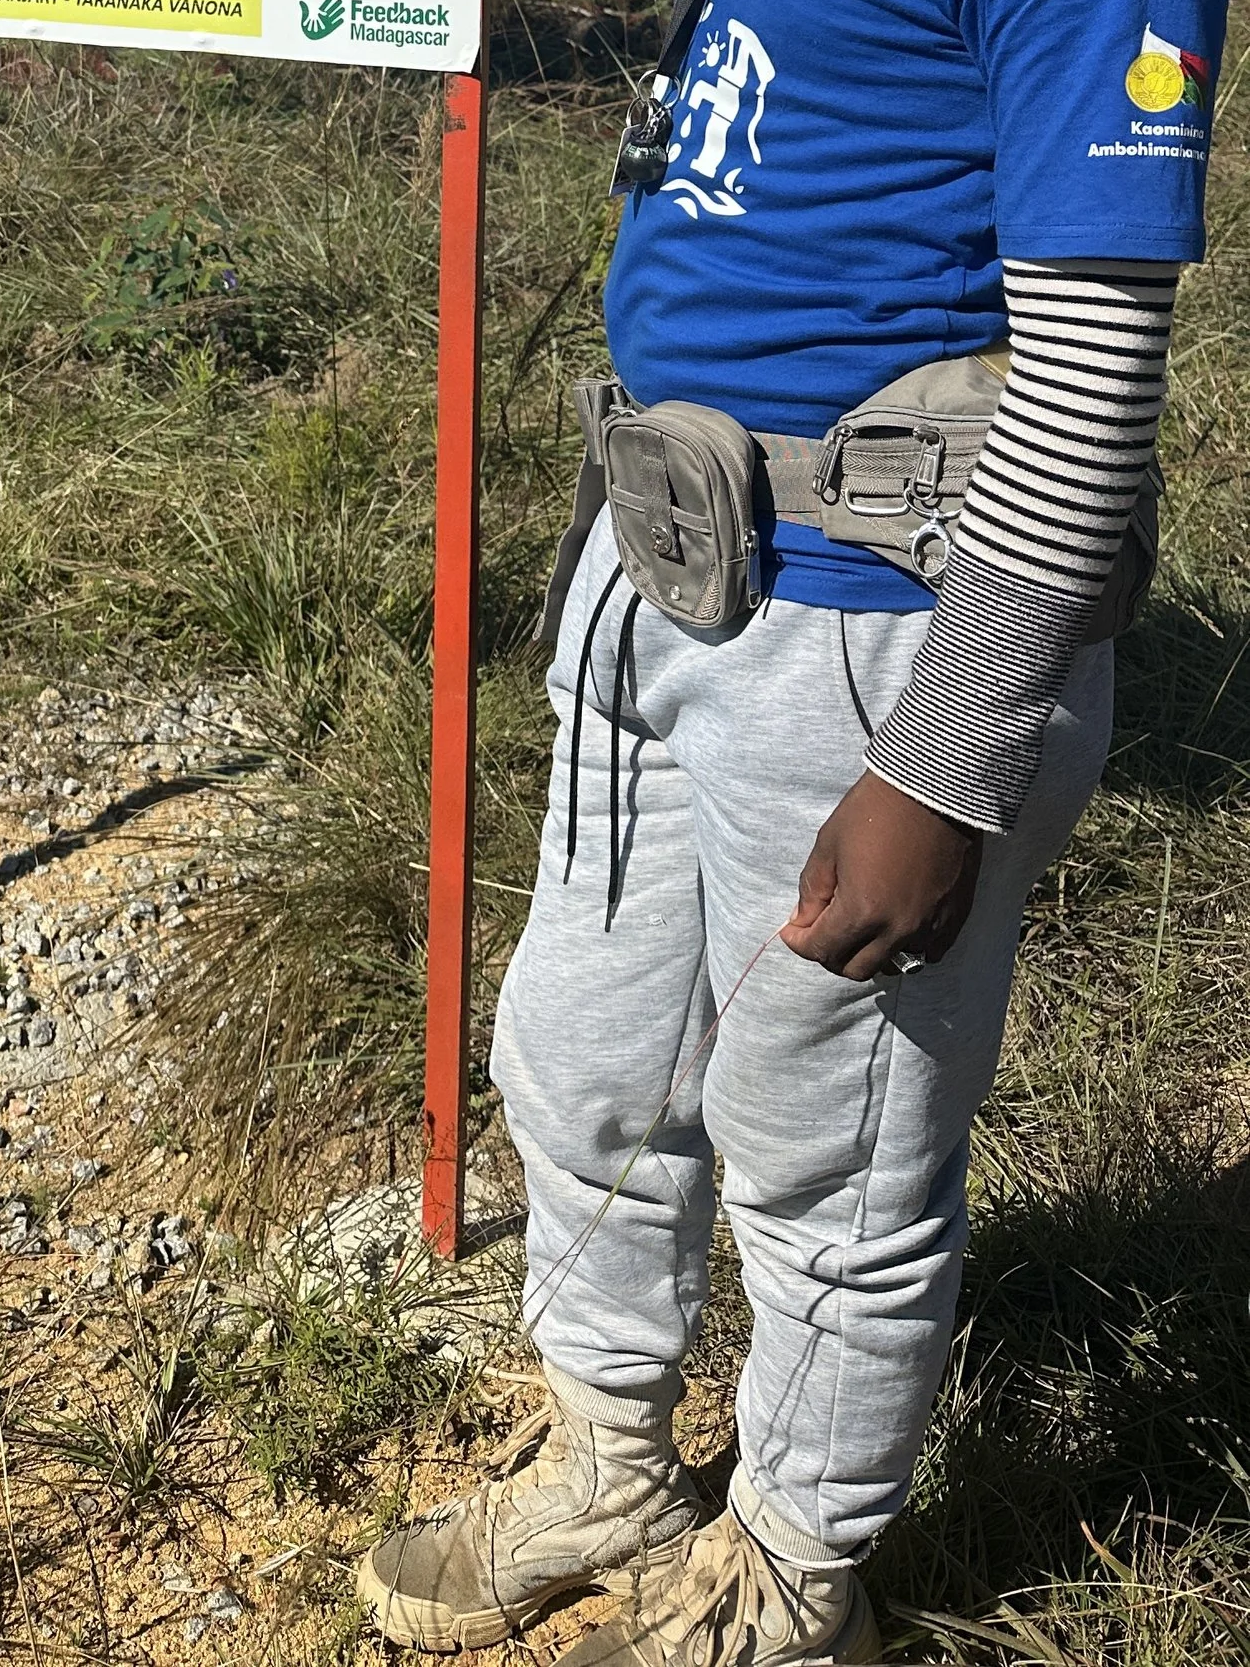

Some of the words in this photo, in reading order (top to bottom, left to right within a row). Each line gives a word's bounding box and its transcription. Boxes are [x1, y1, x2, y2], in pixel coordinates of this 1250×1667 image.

[351, 0, 450, 27] Feedback
[351, 22, 449, 47] Madagascar
[1131, 121, 1205, 140] Kaominina
